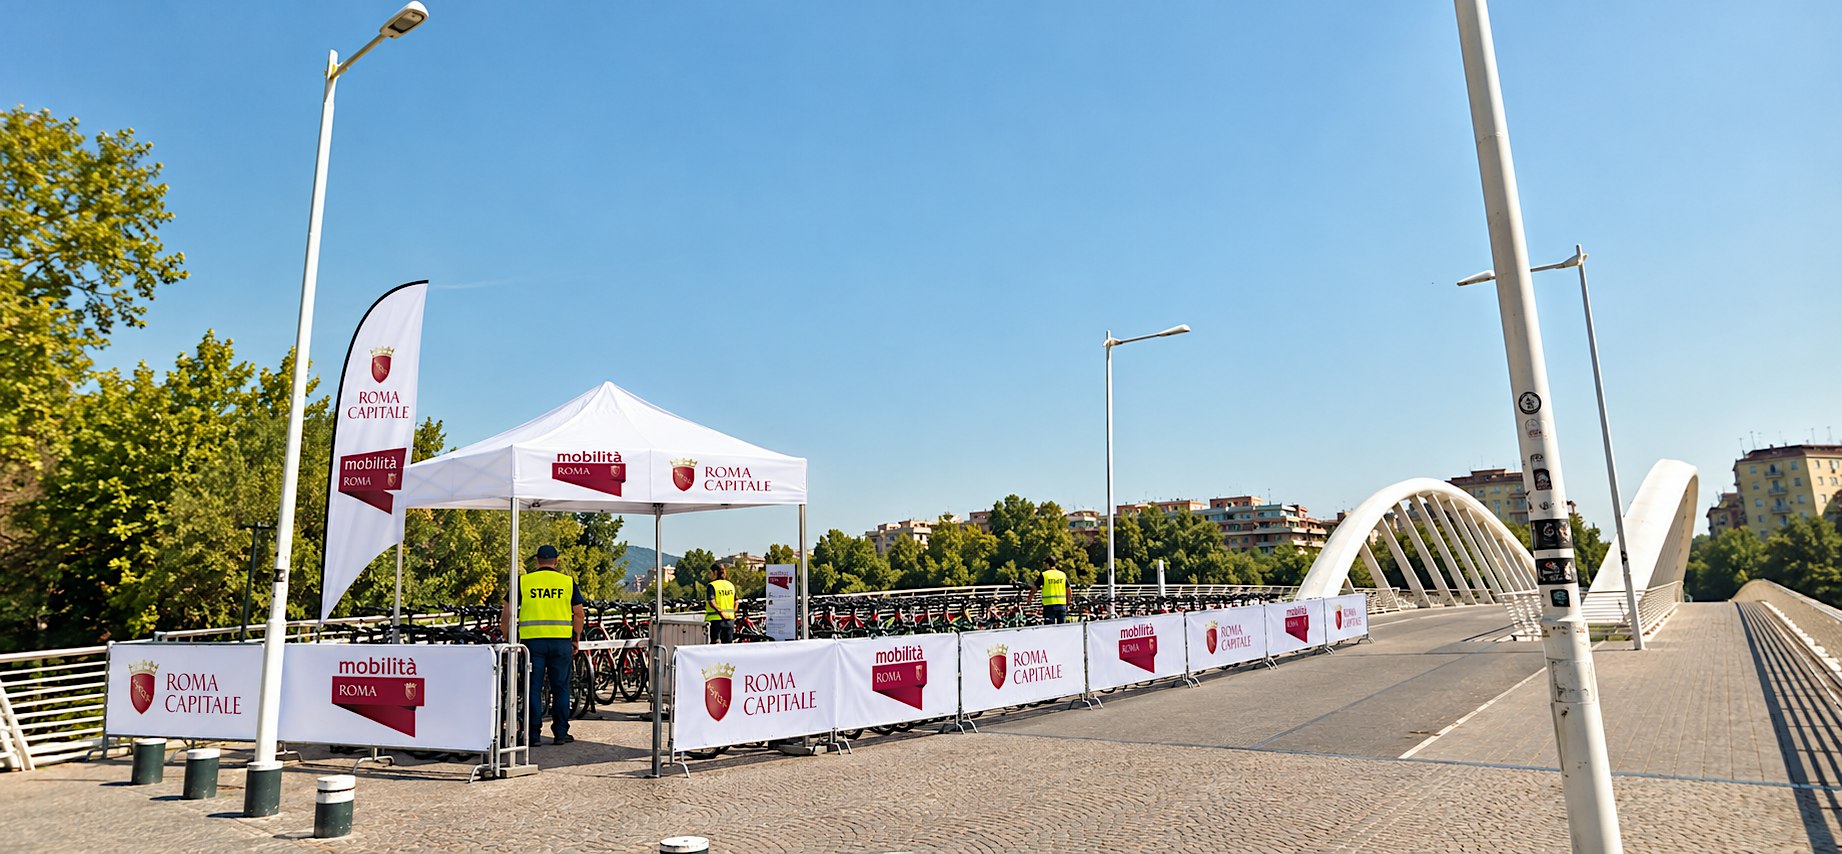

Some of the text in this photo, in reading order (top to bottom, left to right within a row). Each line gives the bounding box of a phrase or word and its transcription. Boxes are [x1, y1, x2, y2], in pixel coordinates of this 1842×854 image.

[358, 391, 400, 404] ROMA
[348, 405, 410, 420] CAPITALE
[344, 456, 397, 470] mobilità
[557, 451, 623, 463] mobilità
[557, 467, 591, 475] ROMA
[705, 466, 752, 479] ROMA
[343, 476, 372, 486] ROMA
[704, 479, 771, 492] CAPITALE
[530, 587, 564, 599] STAFF
[875, 645, 924, 664] mobilità
[1014, 649, 1048, 667] ROMA
[338, 657, 418, 676] mobilità
[876, 671, 902, 684] ROMA
[1013, 664, 1063, 685] CAPITALE
[166, 673, 219, 692] ROMA
[744, 671, 797, 693] ROMA
[339, 685, 377, 697] ROMA
[164, 694, 242, 715] CAPITALE
[743, 690, 817, 715] CAPITALE
